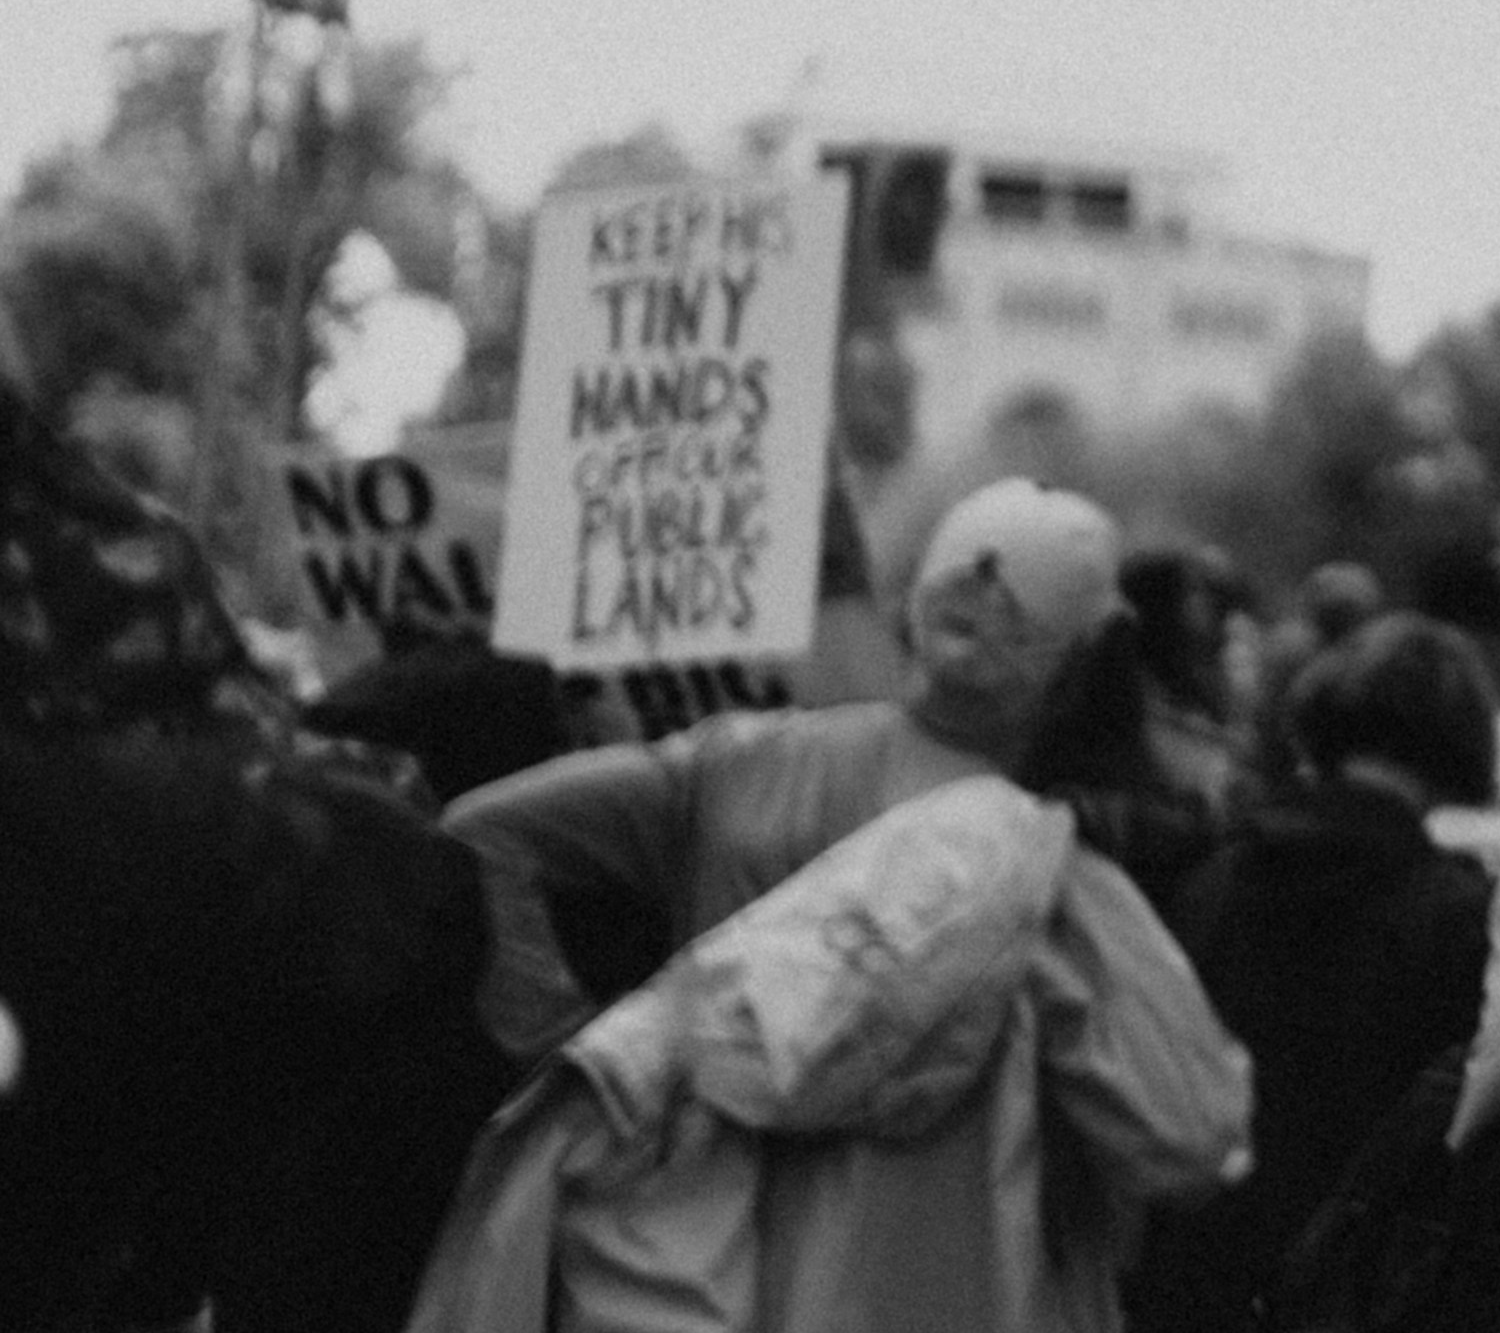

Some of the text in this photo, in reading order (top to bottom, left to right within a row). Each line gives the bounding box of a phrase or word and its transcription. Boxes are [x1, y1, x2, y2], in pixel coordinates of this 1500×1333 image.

[590, 195, 709, 265] KEEP
[591, 266, 758, 351] TINY
[570, 361, 770, 441] HANDS
[286, 455, 435, 537] NO
[573, 431, 669, 495] OFF
[578, 483, 768, 560] PUBLIC
[573, 549, 756, 642] LANDS
